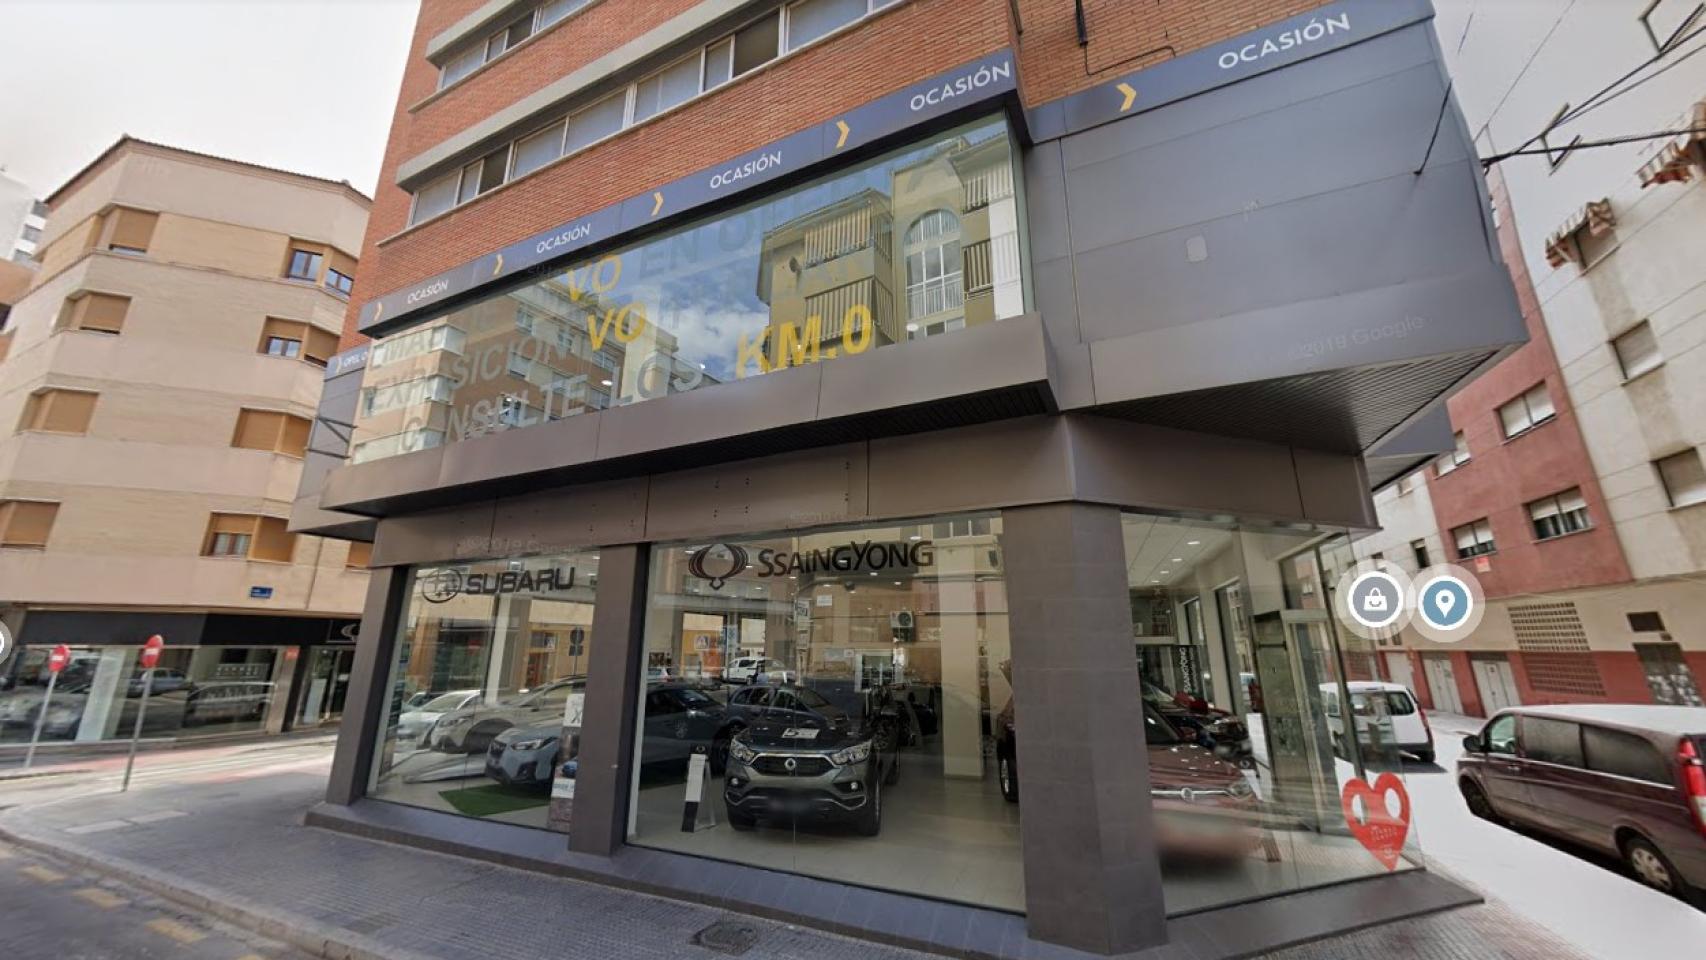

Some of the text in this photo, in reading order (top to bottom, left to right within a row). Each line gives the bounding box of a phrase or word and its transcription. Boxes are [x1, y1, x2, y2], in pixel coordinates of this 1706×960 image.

[1217, 12, 1352, 70] OCASIÓN
[909, 61, 1011, 112] OCASIÓN
[709, 151, 782, 190] OCASIÓN
[536, 223, 591, 254] OCASIÓN
[407, 278, 449, 305] OCASIÓN
[567, 254, 623, 302] VO
[587, 302, 646, 352] VO
[735, 304, 873, 380] KM.0
[465, 566, 576, 595] SUBARU
